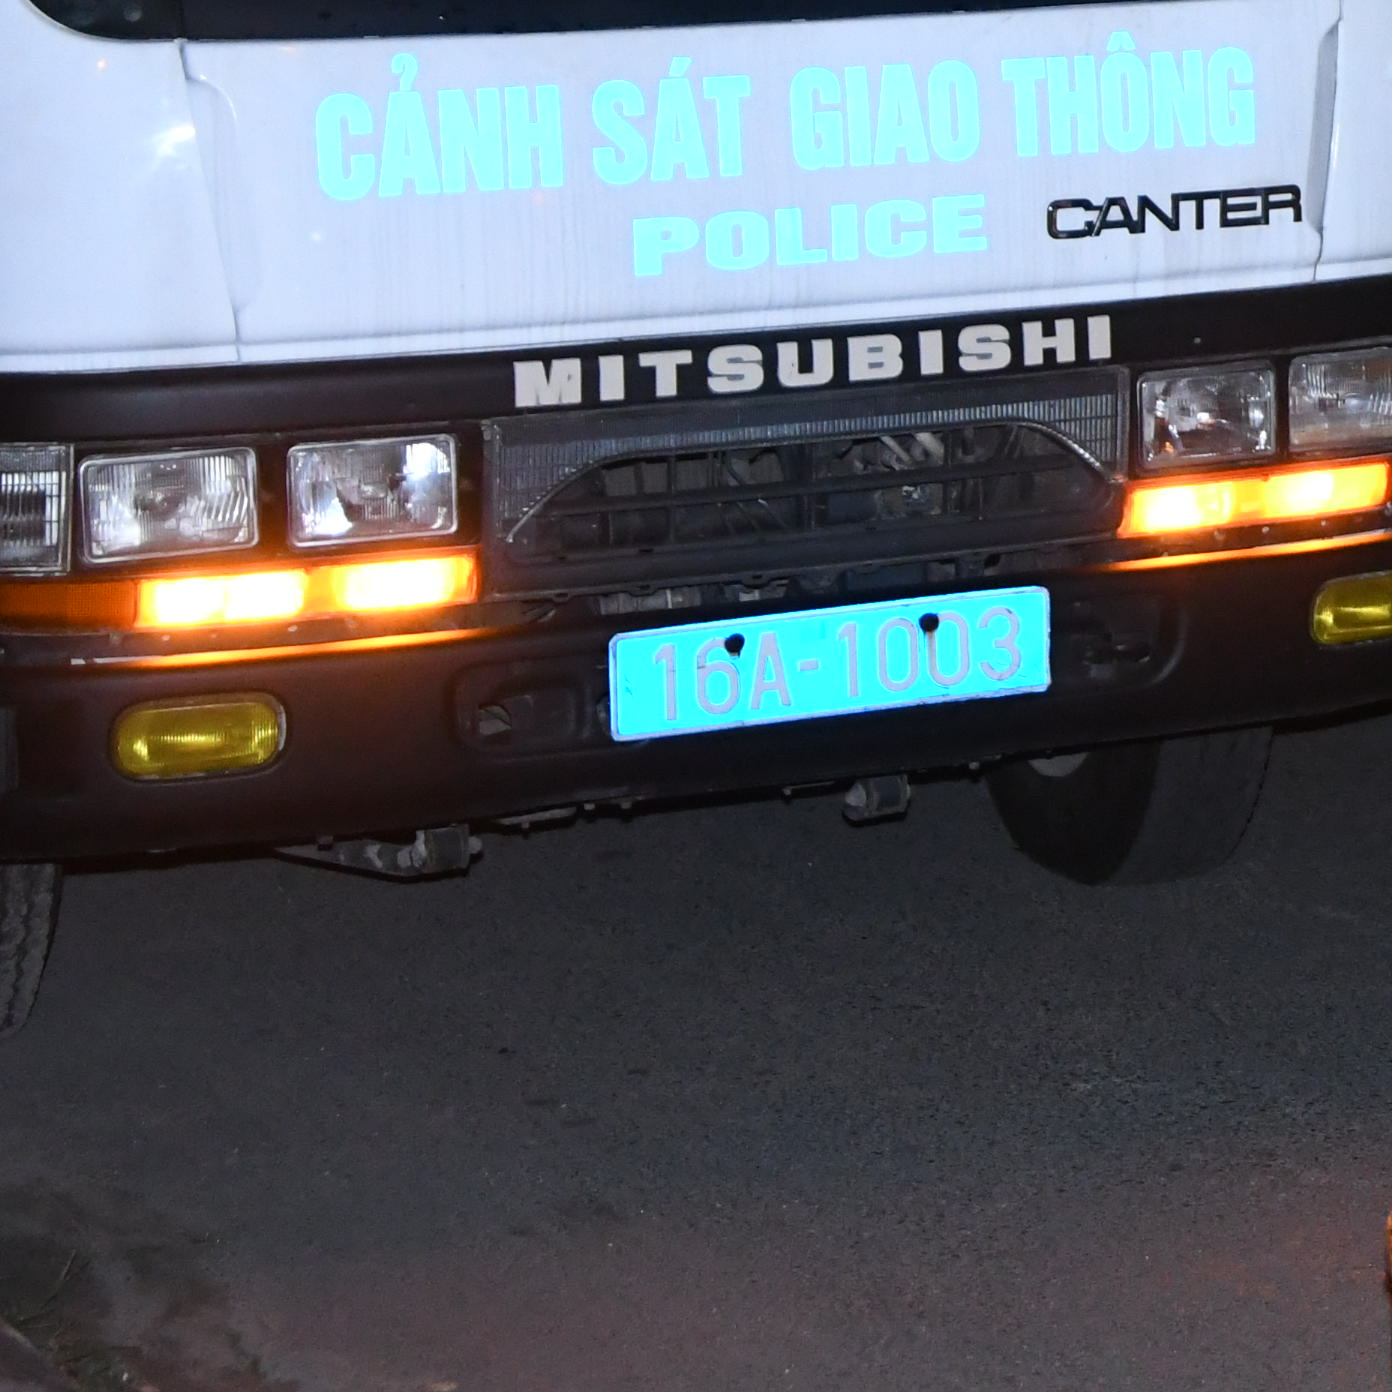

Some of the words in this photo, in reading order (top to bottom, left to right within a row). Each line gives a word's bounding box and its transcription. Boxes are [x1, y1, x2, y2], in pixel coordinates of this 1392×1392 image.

[316, 52, 563, 201] CẢNH
[592, 56, 753, 186] SÁT
[790, 60, 980, 171] GIAO
[1002, 32, 1256, 159] THÔNG
[633, 192, 989, 277] POLICE
[1046, 185, 1303, 240] CANTER
[513, 313, 1112, 408] MITSUBISHI
[654, 606, 1023, 721] 16A-1003
